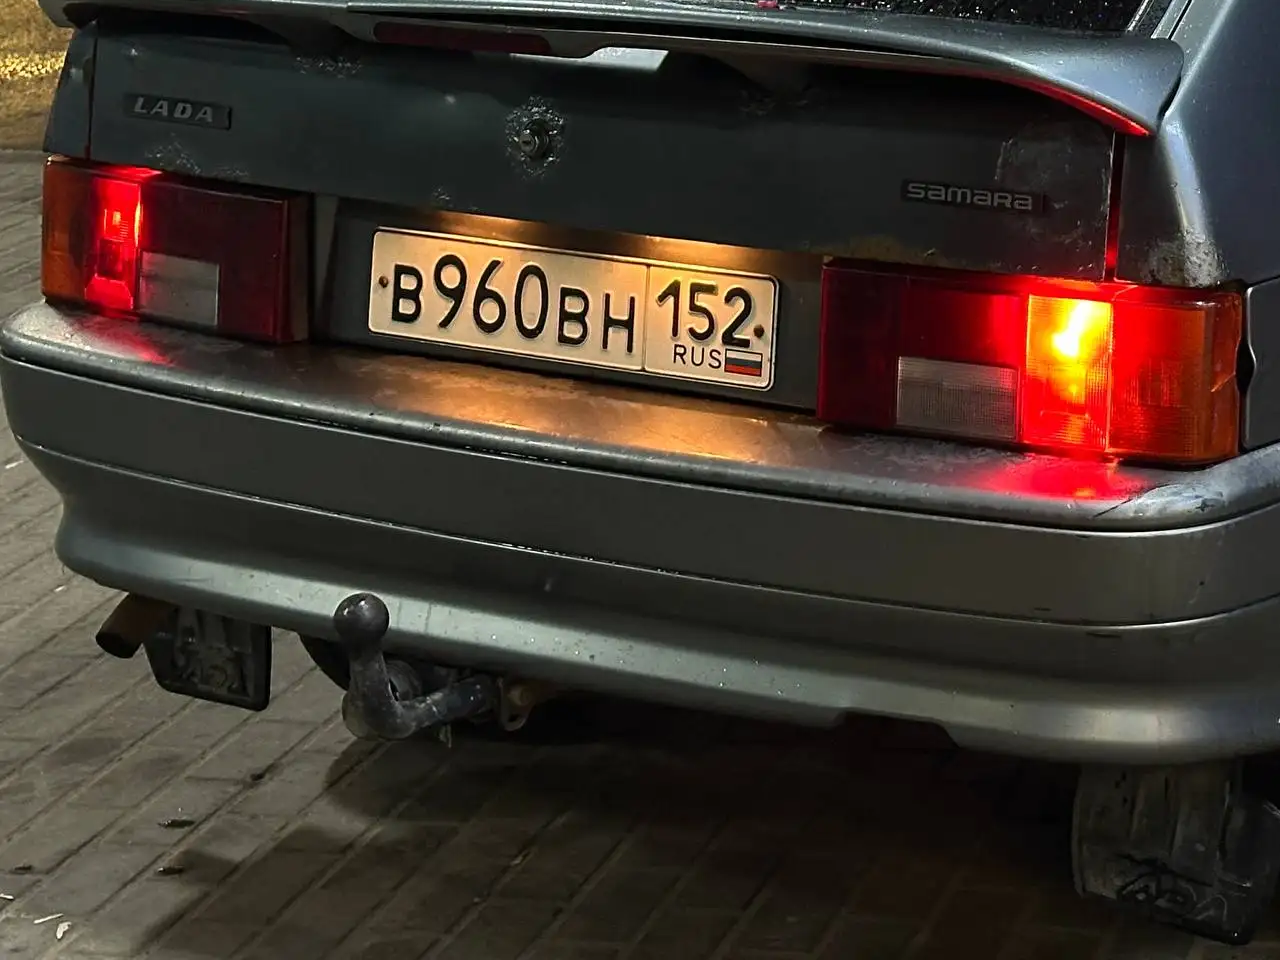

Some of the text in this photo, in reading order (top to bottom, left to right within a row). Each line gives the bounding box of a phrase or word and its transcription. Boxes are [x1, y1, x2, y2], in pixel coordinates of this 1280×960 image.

[134, 96, 213, 122] LADA
[655, 278, 753, 349] 152
[672, 342, 722, 370] RUS
